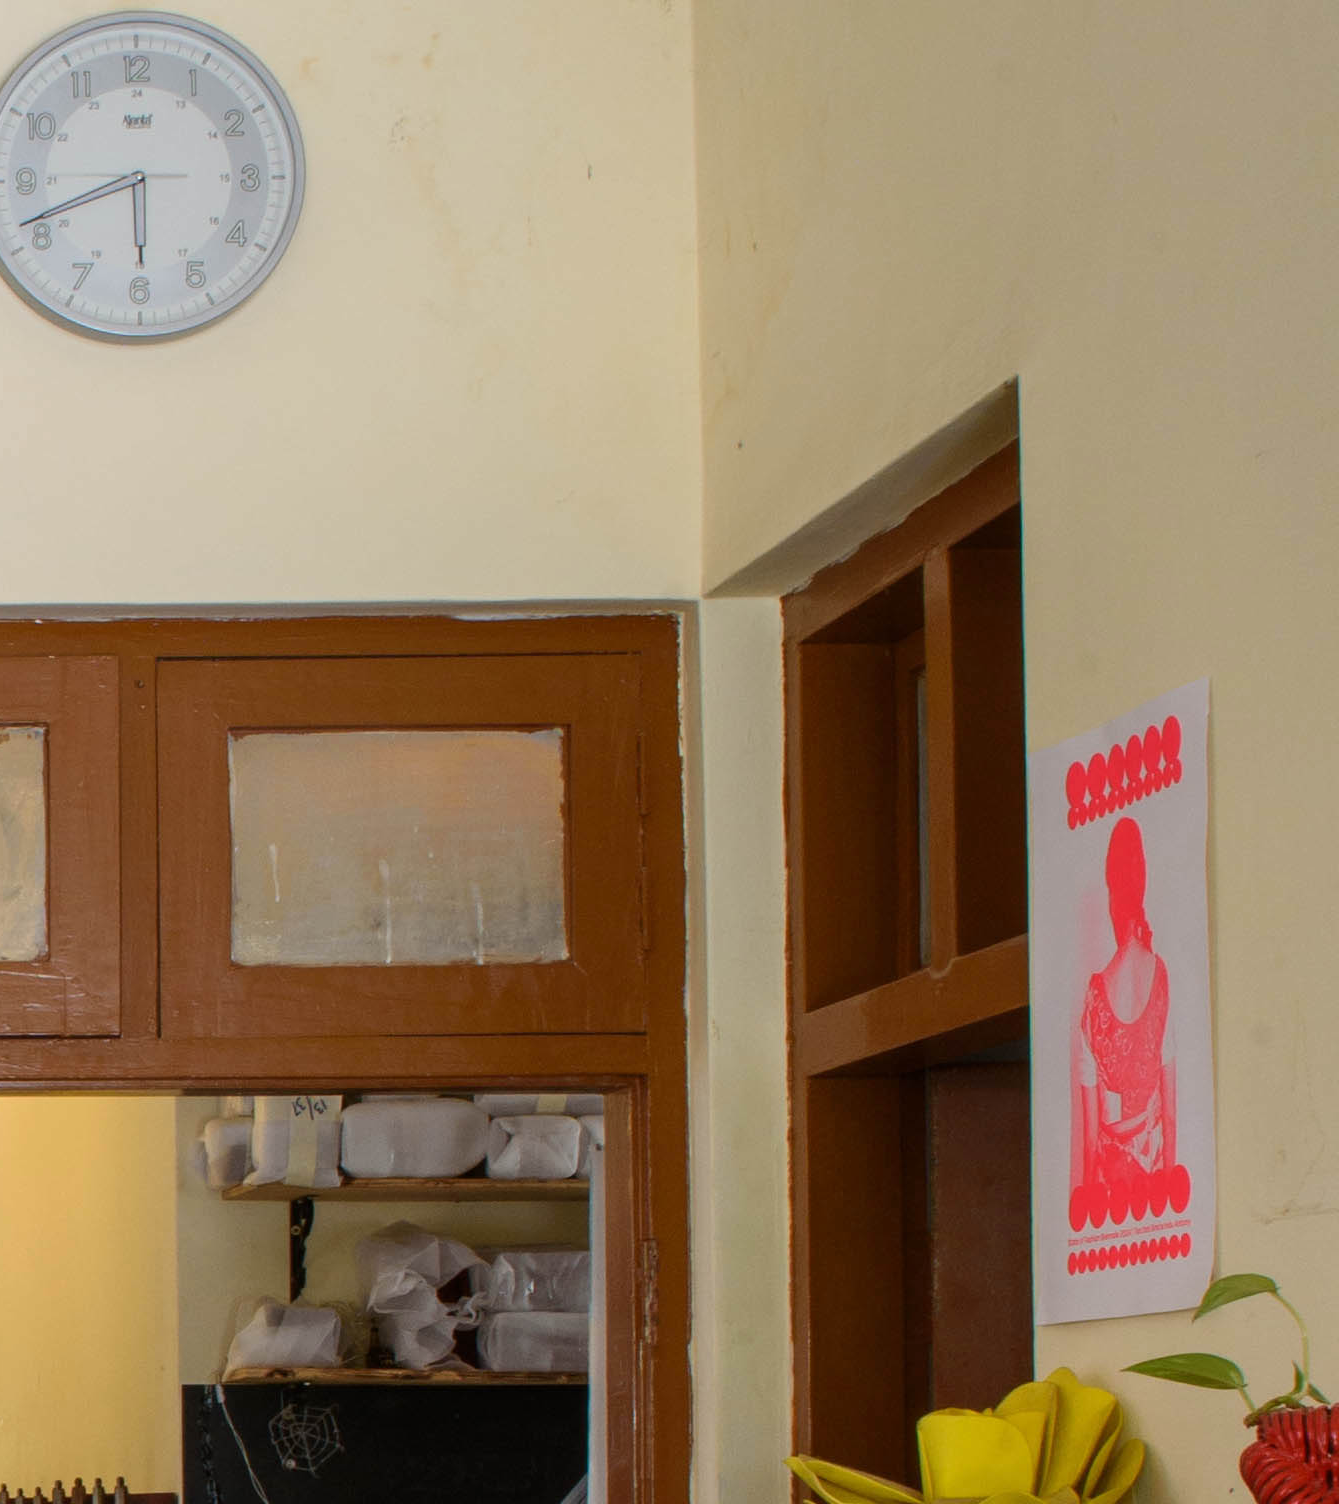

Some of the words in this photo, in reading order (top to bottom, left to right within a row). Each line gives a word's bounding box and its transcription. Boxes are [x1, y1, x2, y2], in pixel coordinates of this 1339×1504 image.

[123, 55, 151, 83] 12
[189, 69, 198, 96] 1
[71, 70, 92, 97] 11
[131, 89, 143, 98] 24
[88, 101, 100, 110] 23
[176, 101, 186, 110] 13
[26, 112, 56, 141] 10
[207, 130, 218, 139] 14
[224, 109, 245, 137] 2
[57, 133, 69, 142] 22
[15, 167, 36, 195] 9
[46, 176, 57, 185] 21
[219, 174, 230, 183] 15
[240, 163, 260, 192] 3
[58, 219, 70, 228] 20
[208, 217, 219, 226] 16
[225, 219, 247, 247] 4
[32, 222, 52, 250] 8
[91, 250, 101, 259] 19
[177, 248, 188, 257] 17
[72, 262, 95, 291] 7
[186, 261, 206, 289] 5
[129, 276, 151, 305] 6
